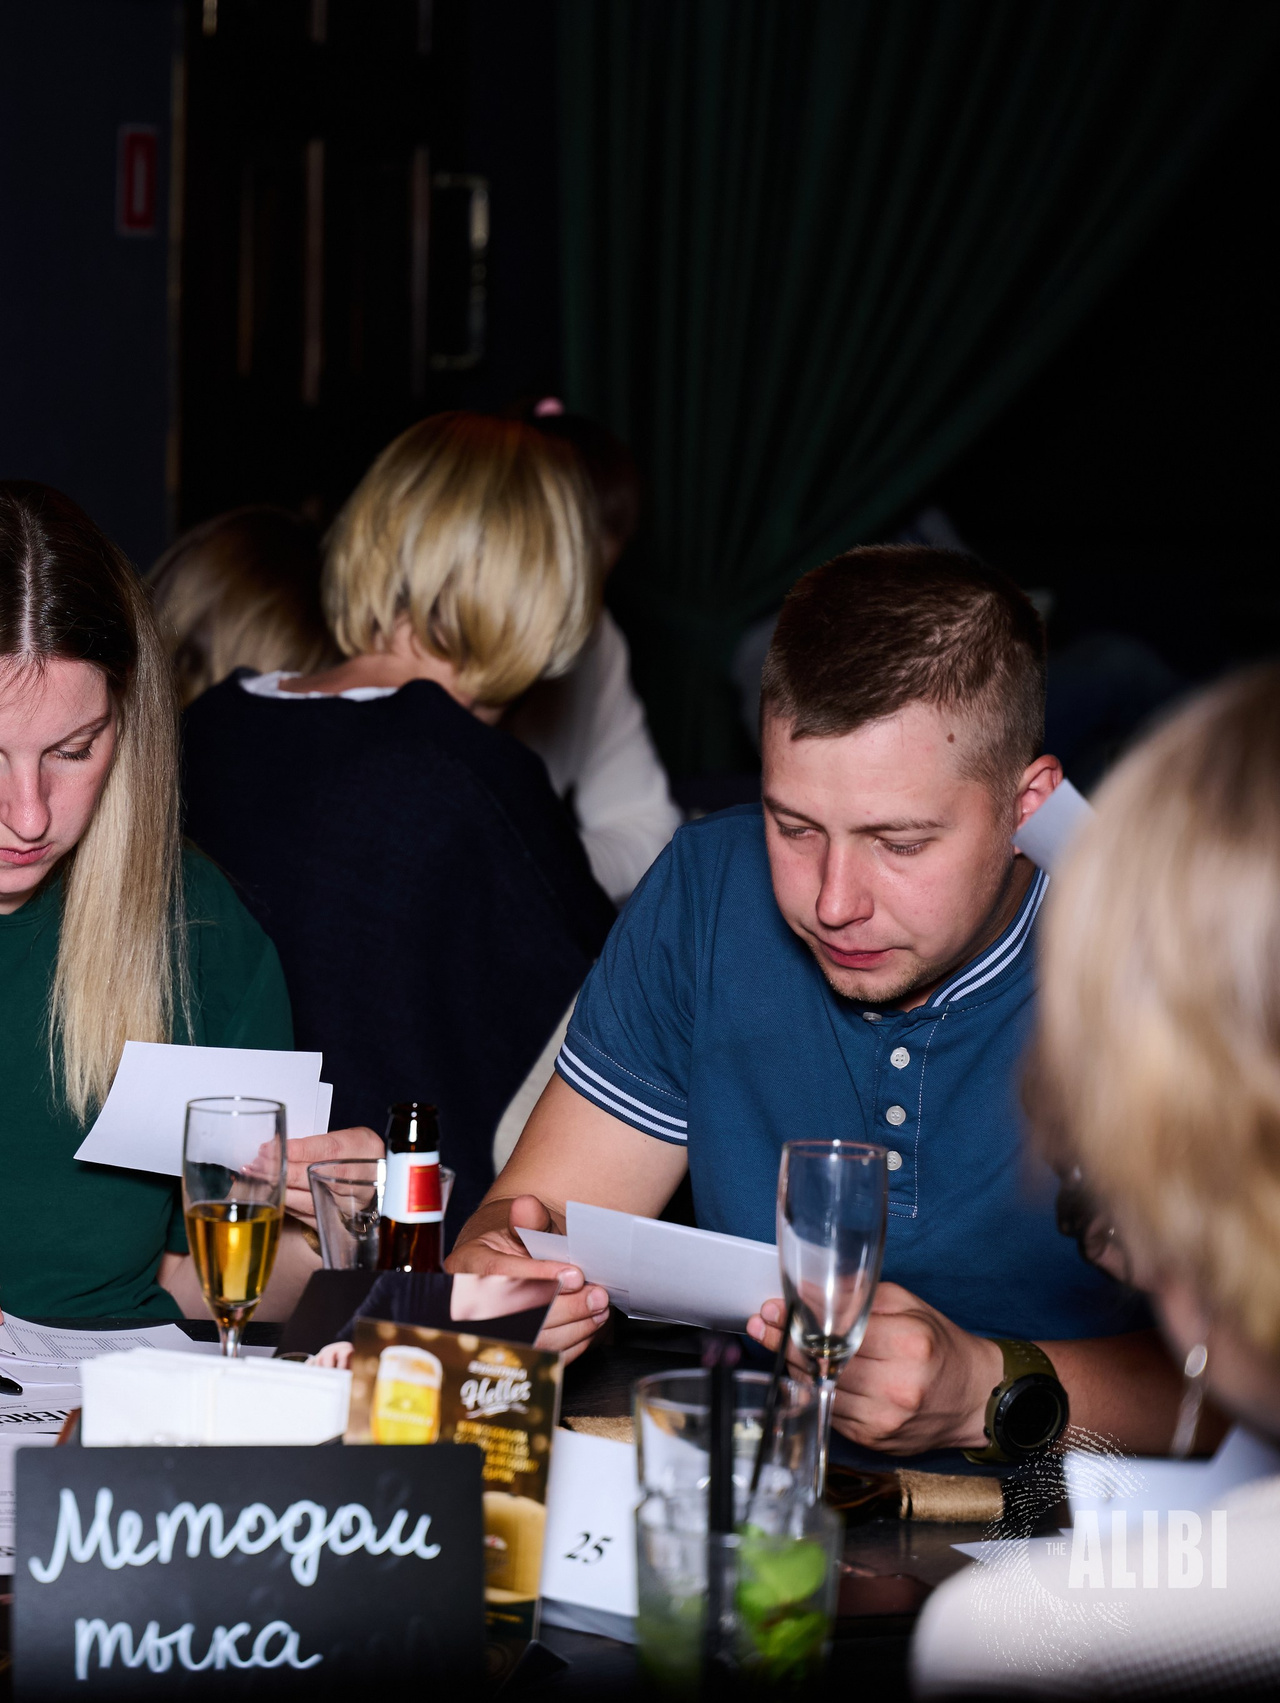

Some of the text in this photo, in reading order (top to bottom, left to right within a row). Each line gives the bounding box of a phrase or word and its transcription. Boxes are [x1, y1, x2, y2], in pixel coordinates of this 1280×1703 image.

[28, 1487, 442, 1587] Методом
[564, 1531, 613, 1565] 25
[74, 1617, 324, 1681] тыка
